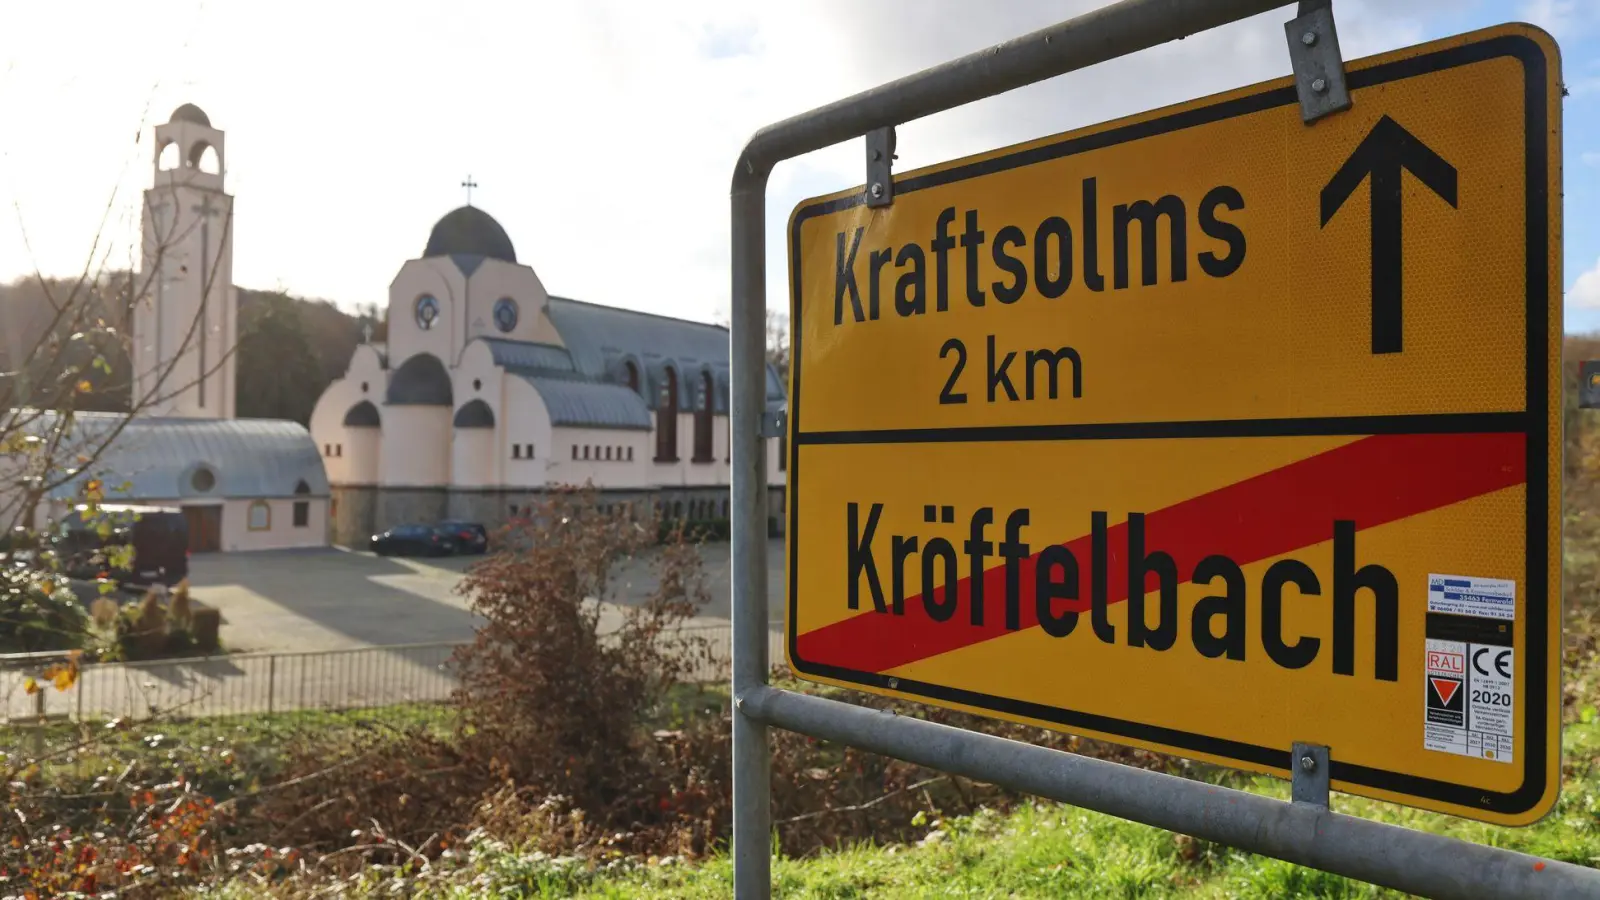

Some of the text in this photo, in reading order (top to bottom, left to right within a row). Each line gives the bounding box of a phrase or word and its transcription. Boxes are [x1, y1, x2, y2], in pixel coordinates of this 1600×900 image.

[834, 176, 1247, 326] Kraftsolms
[939, 335, 1082, 404] 2 km
[846, 501, 1399, 682] Kröffelbach
[1459, 594, 1513, 605] 35463 Fernwald
[1430, 654, 1460, 670] RAL
[1472, 647, 1512, 679] CE
[1472, 689, 1511, 707] 2020
